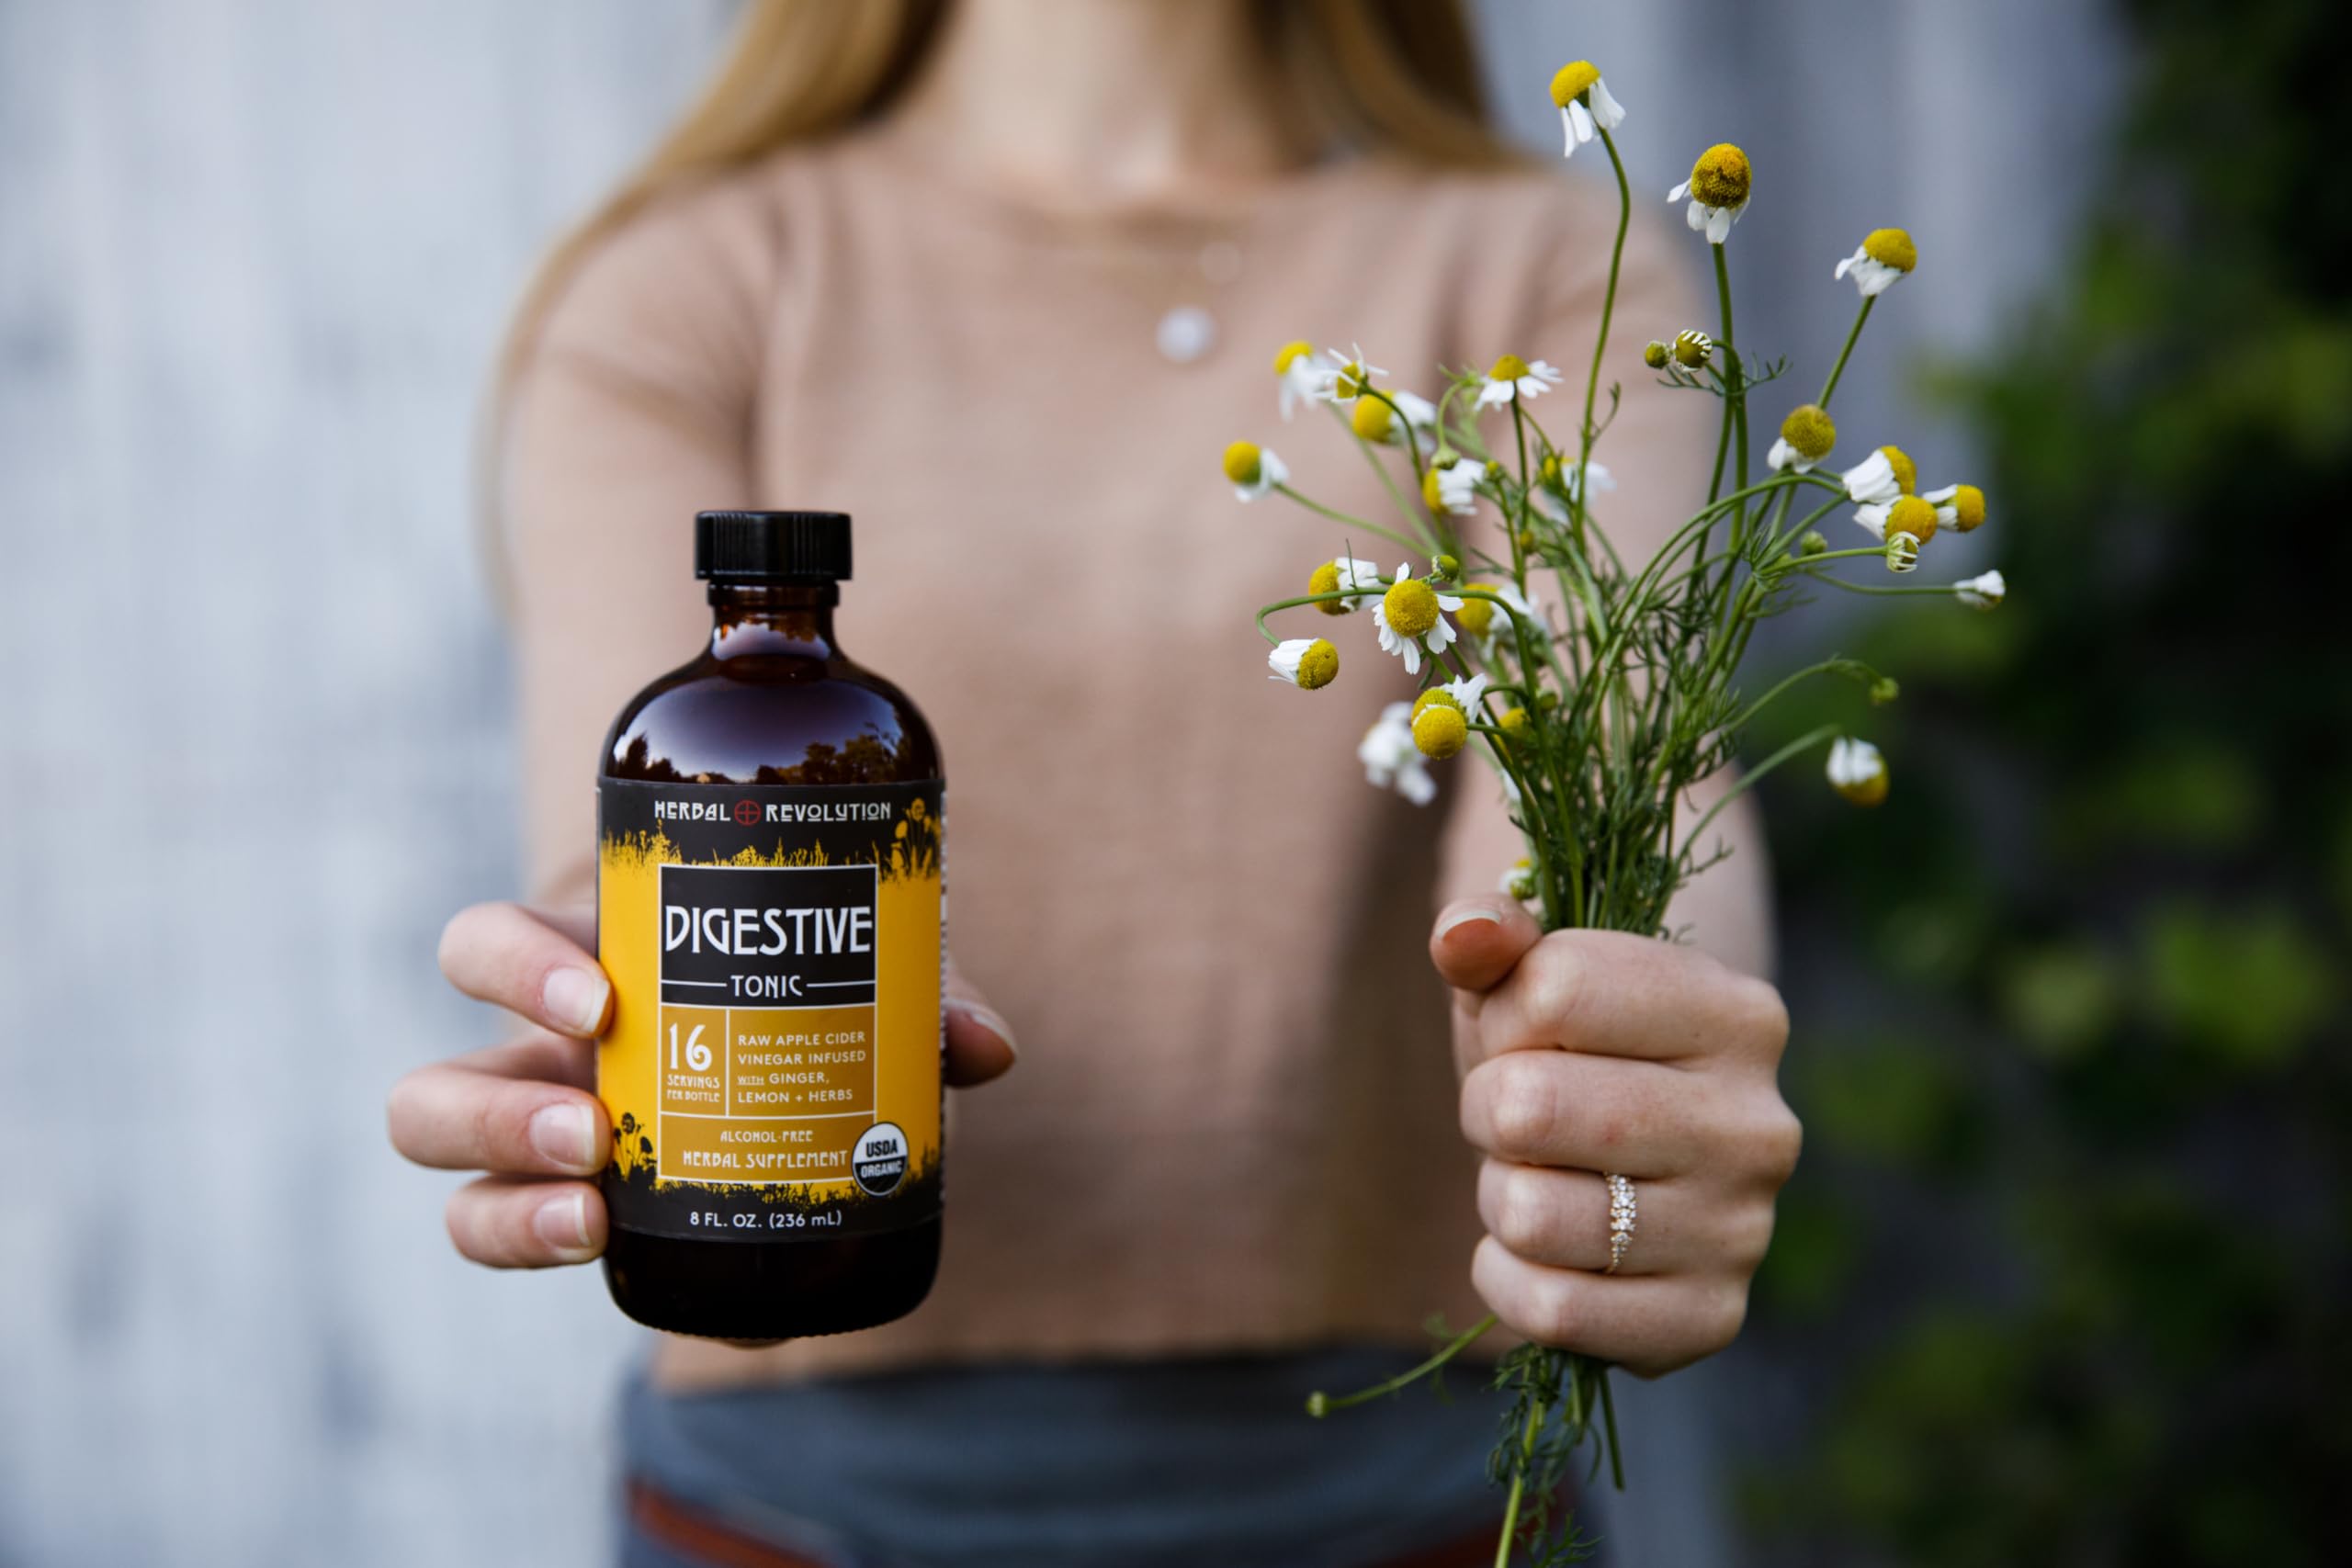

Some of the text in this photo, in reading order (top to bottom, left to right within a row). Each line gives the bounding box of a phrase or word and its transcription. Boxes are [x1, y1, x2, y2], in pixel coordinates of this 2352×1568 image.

[654, 800, 891, 822] HERBAL REVOLUTION
[665, 906, 873, 954] DIGESTIVE
[730, 976, 803, 998] TONIC
[669, 1022, 713, 1071] 16
[738, 1032, 865, 1046] RAW APPLE CIDER
[738, 1051, 866, 1066] VINEGAR INFUSED
[667, 1074, 720, 1089] SERVINGS
[769, 1072, 829, 1086] GINGER,
[667, 1091, 720, 1102] PER BOTTLE
[738, 1091, 789, 1103] LEMON
[808, 1089, 853, 1102] HERBS
[865, 1138, 899, 1157] USDA
[683, 1150, 848, 1168] HERBAL SUPPLEMENT
[861, 1160, 902, 1179] ORGANIC
[690, 1210, 843, 1229] 8 FL. OZ. (236 mL)
